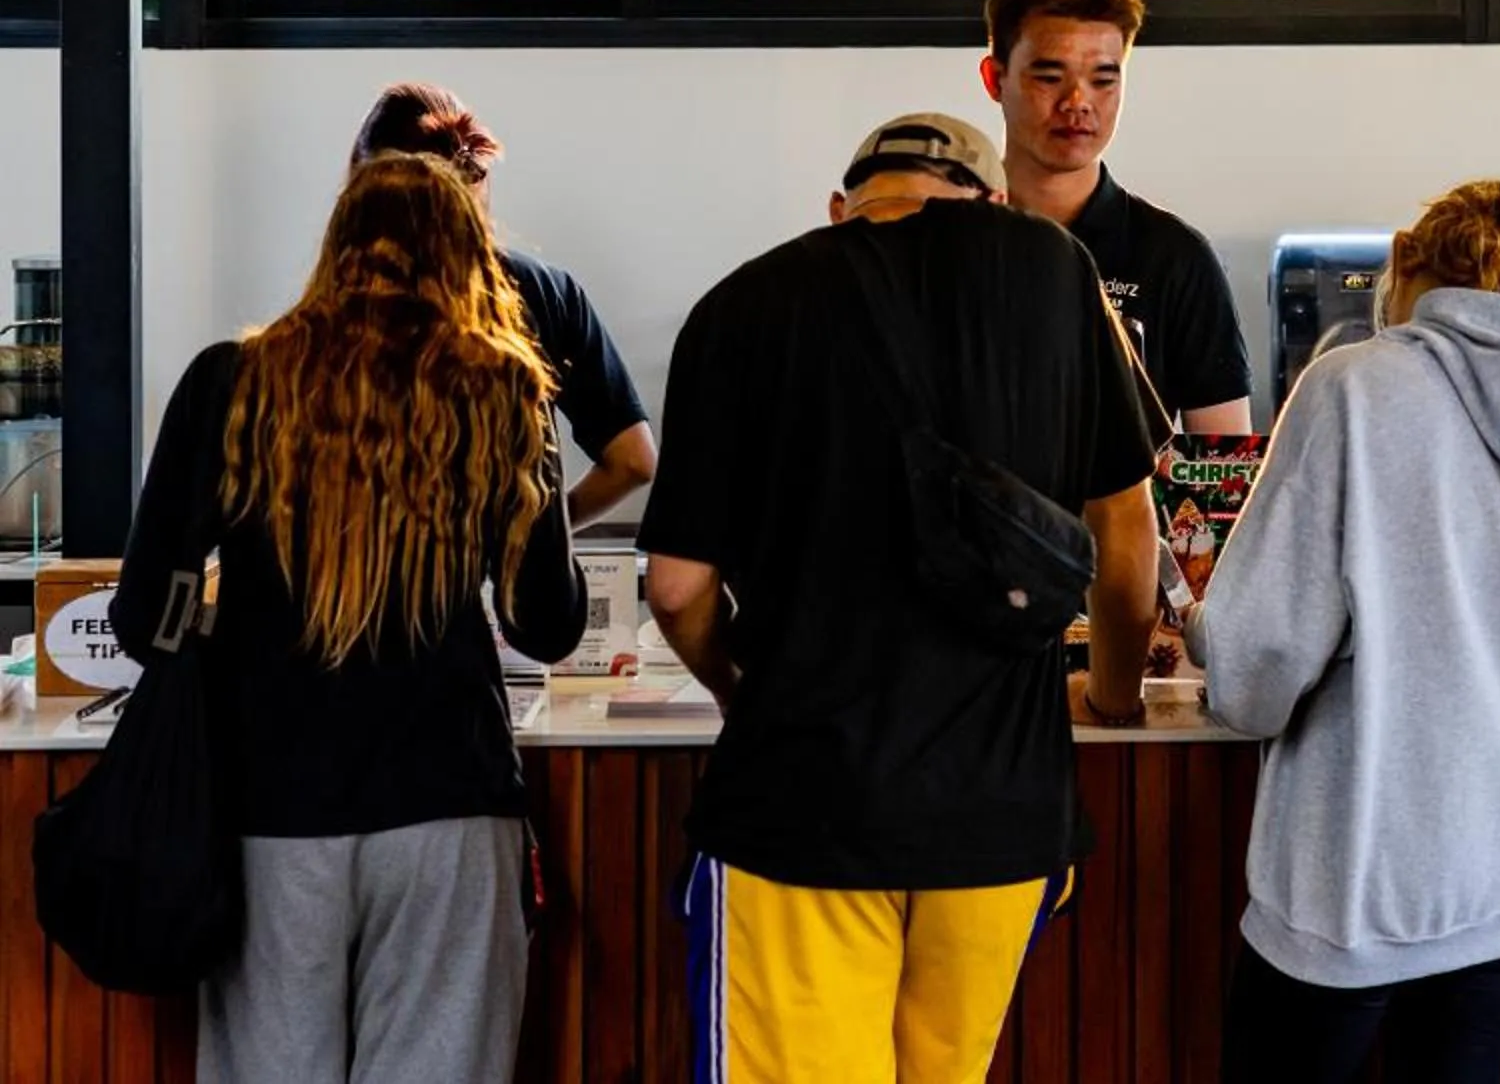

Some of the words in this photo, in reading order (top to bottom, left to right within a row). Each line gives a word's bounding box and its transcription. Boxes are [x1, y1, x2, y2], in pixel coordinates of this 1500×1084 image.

[1101, 277, 1139, 297] derz
[71, 619, 114, 635] FEE
[86, 643, 121, 659] TIP
